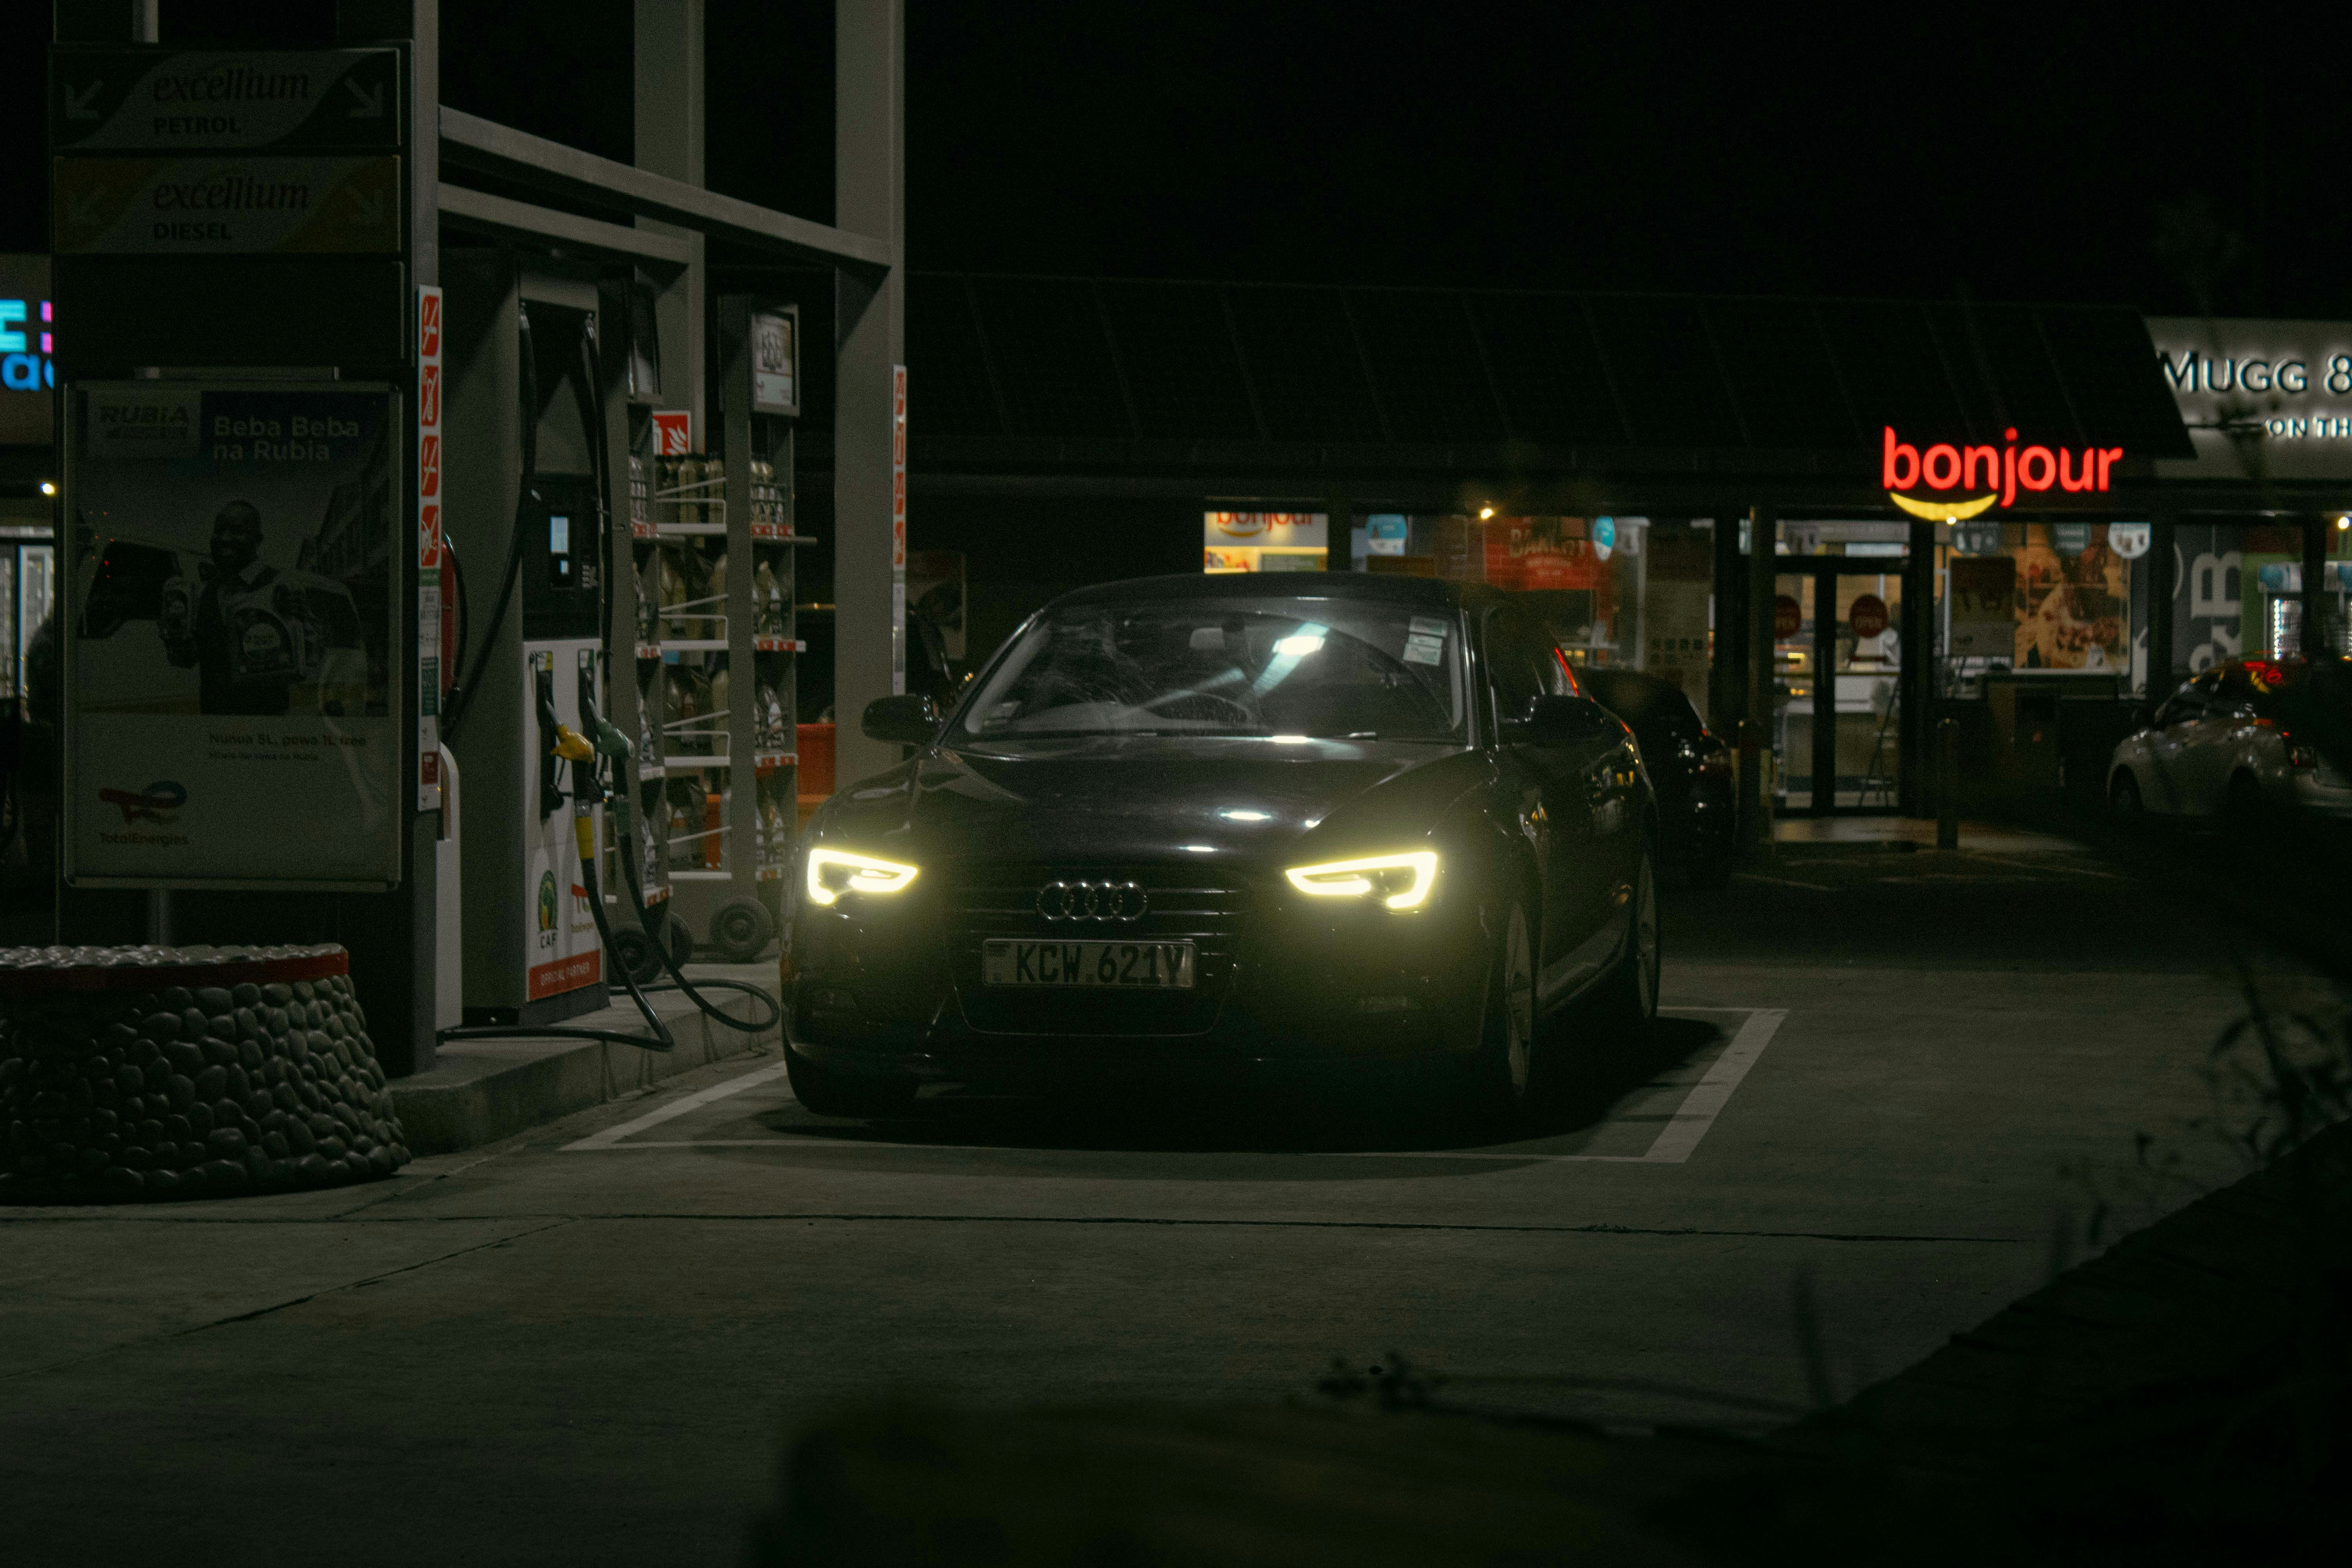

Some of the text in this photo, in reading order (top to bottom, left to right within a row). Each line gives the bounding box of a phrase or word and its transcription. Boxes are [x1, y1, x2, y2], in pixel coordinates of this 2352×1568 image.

[152, 67, 309, 102] excellium
[154, 116, 241, 136] PETROL
[152, 176, 309, 210] excellium
[153, 222, 232, 241] DIESEL
[2156, 350, 2308, 394] MUGG
[214, 414, 281, 437] Beba
[291, 414, 359, 437] Beba
[2265, 417, 2308, 439] ON
[213, 439, 330, 461] na Rubia
[1883, 425, 2124, 509] bonjour
[99, 832, 189, 848] TotalEnergies
[540, 933, 557, 949] CAF
